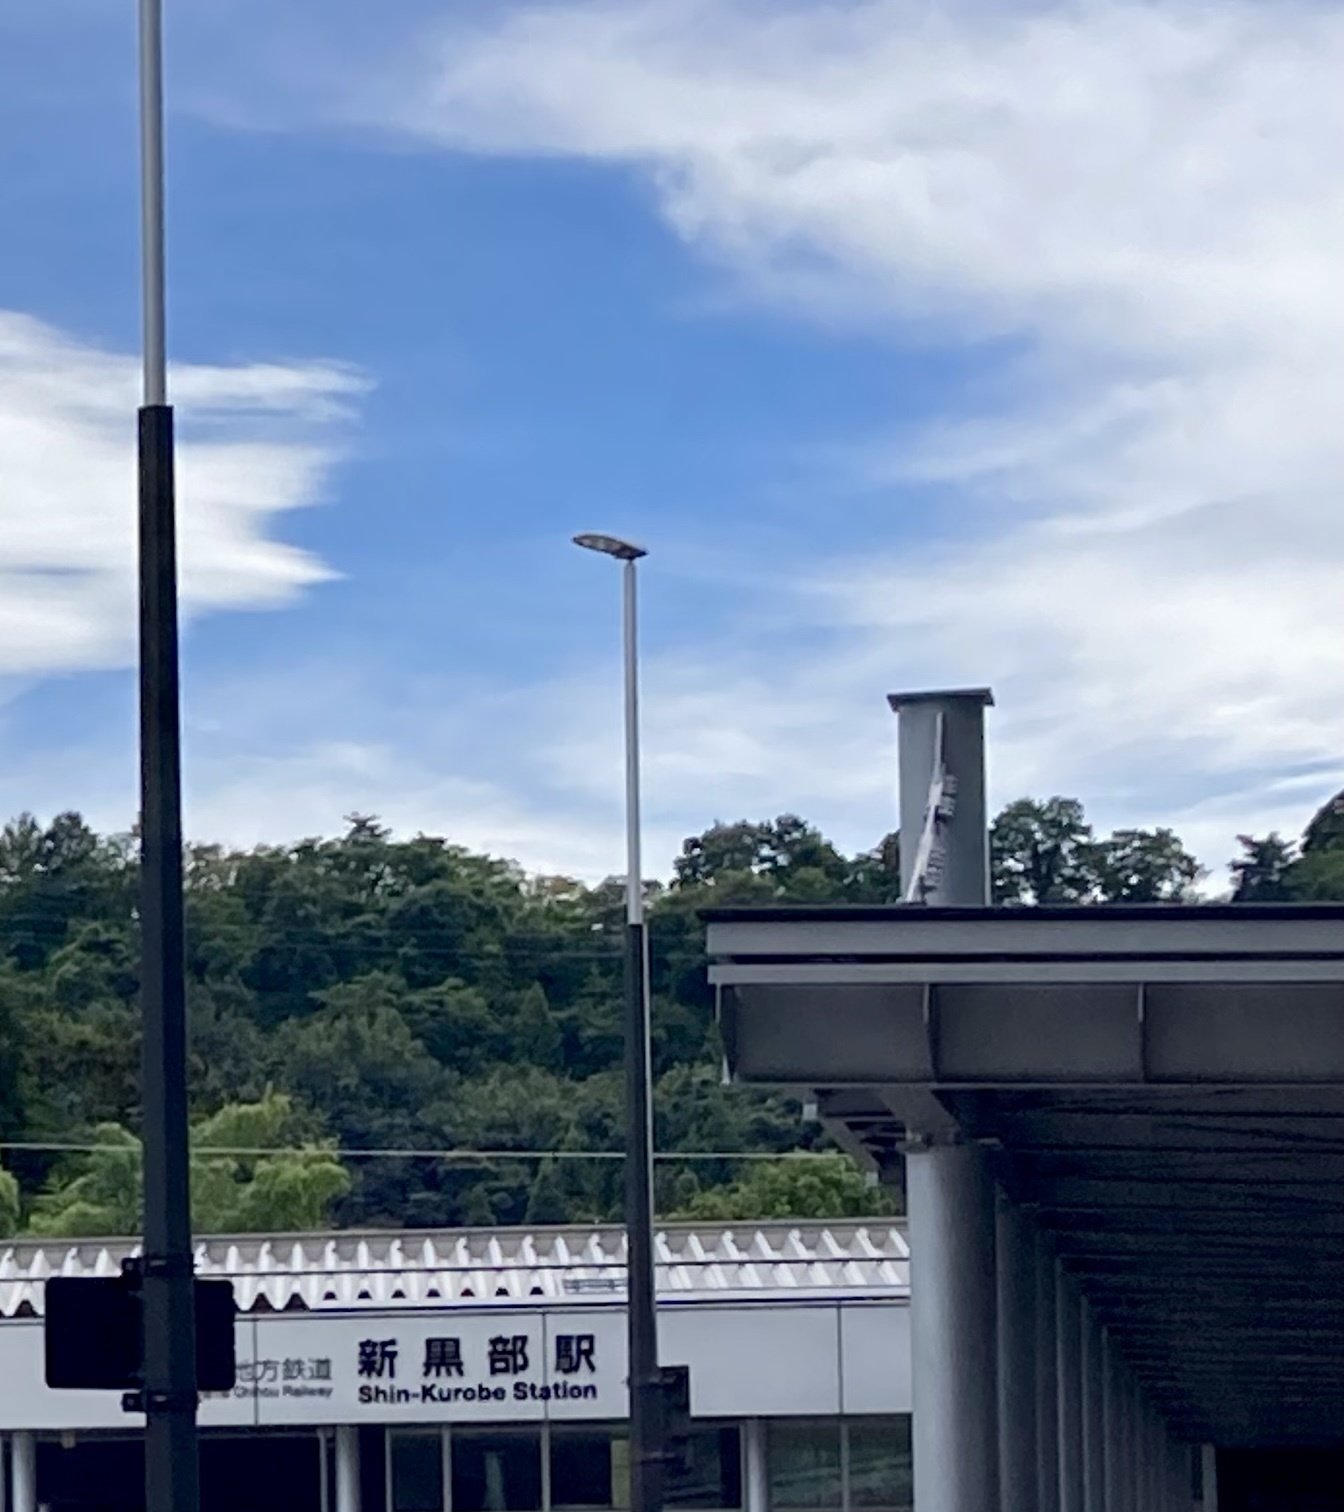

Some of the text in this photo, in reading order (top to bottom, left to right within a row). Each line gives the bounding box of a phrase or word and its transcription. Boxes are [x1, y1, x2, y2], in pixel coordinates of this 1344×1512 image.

[358, 1334, 596, 1378] 新黒部駅
[283, 1386, 333, 1398] Railway
[358, 1381, 598, 1404] Shin-Kurobe Station
